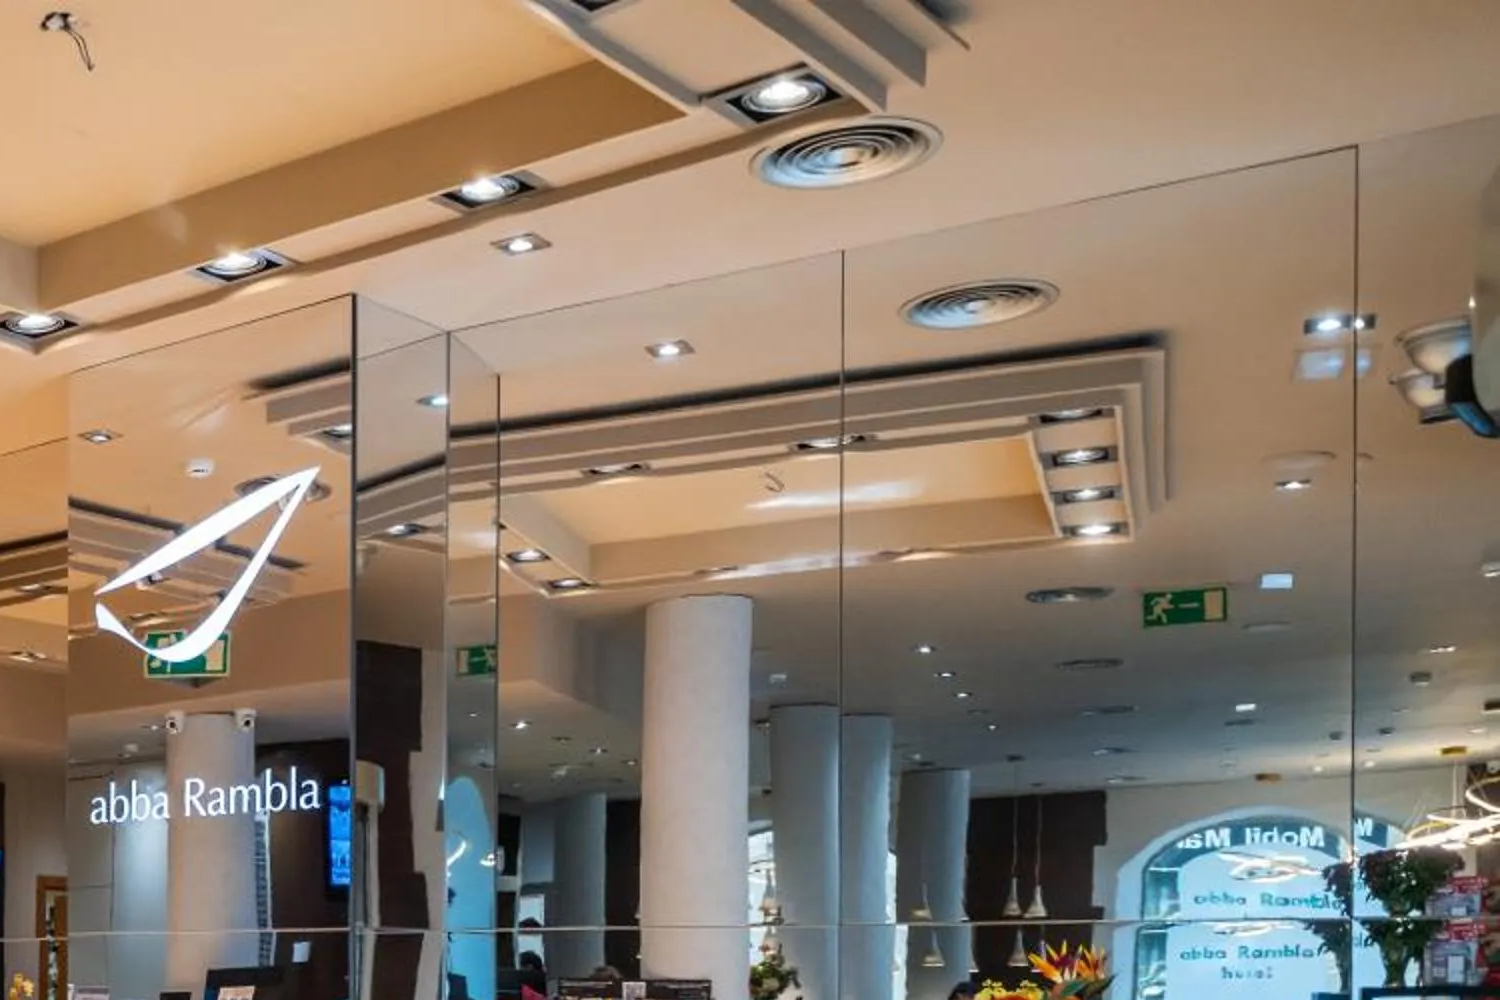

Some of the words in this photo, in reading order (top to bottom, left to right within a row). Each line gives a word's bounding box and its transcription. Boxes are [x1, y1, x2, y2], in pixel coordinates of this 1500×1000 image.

[90, 780, 170, 825] abba
[183, 765, 321, 818] Rambla
[1180, 945, 1227, 960] abba
[1238, 943, 1314, 960] Rambla
